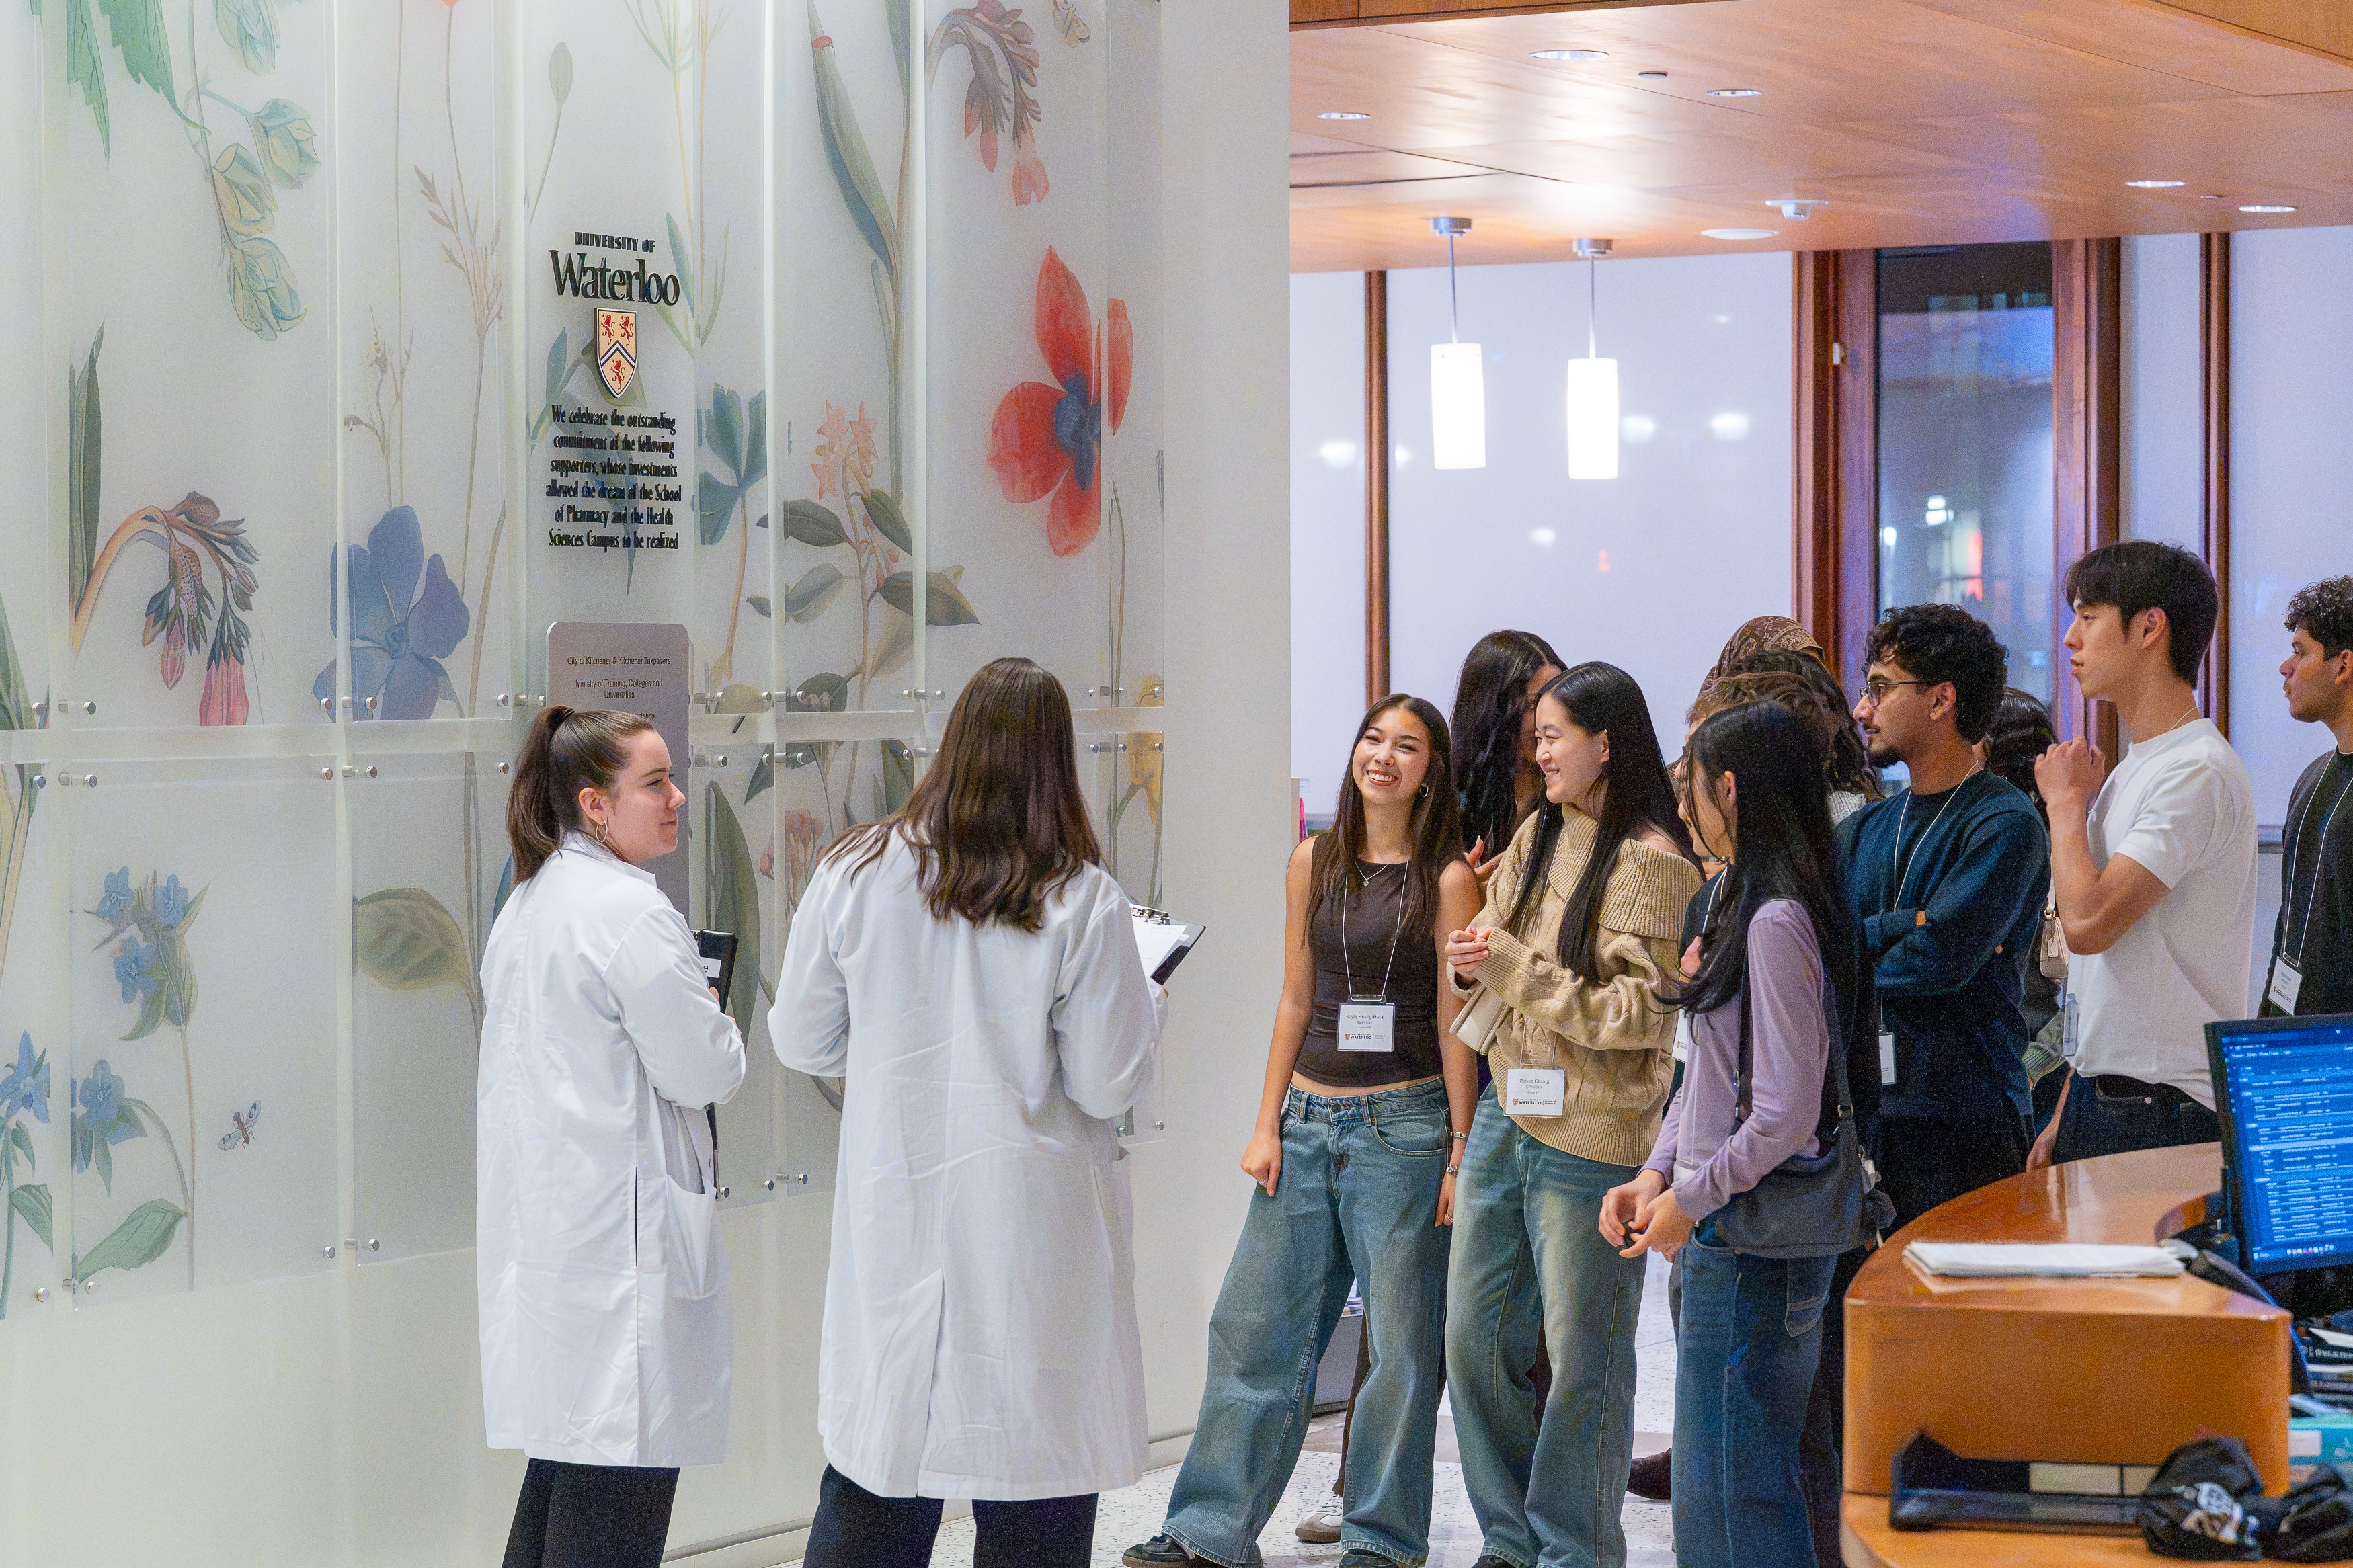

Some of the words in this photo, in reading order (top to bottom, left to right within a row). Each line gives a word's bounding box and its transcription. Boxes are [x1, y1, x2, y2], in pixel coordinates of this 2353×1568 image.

[575, 231, 639, 251] UNIVERSITY
[642, 239, 655, 253] OF
[548, 249, 680, 306] Waterloo
[551, 404, 566, 423] We
[569, 407, 608, 426] celebrate
[610, 409, 625, 427] the
[627, 412, 676, 436] outstanding
[553, 431, 606, 450] commitment
[610, 433, 620, 451] of
[621, 434, 635, 452] the
[637, 435, 675, 460] following
[550, 459, 598, 478] supporters,
[601, 457, 627, 475] whose
[629, 458, 678, 478] investments
[546, 479, 579, 498] allowed
[582, 480, 596, 499] the
[598, 480, 626, 499] dream
[628, 482, 638, 500] of
[639, 483, 653, 501] the
[655, 483, 682, 502] School
[555, 504, 565, 522] of
[566, 505, 610, 529] Pharmacy
[611, 506, 627, 524] and
[630, 507, 644, 524] the
[646, 507, 674, 526] Health
[549, 528, 584, 547] Sciences
[586, 530, 619, 553] Campus
[622, 534, 631, 548] to
[633, 530, 644, 549] be
[646, 532, 679, 550] realized
[567, 656, 578, 667] City
[580, 656, 586, 665] of
[586, 656, 611, 665] Kitchener
[612, 657, 617, 665] &
[618, 657, 643, 665] Kitchener
[644, 656, 671, 666] Taxpayers
[575, 679, 597, 689] Ministry
[597, 679, 604, 687] of
[604, 679, 627, 689] Training,
[628, 679, 651, 688] Colleges
[652, 679, 663, 687] and
[604, 690, 635, 698] Universities
